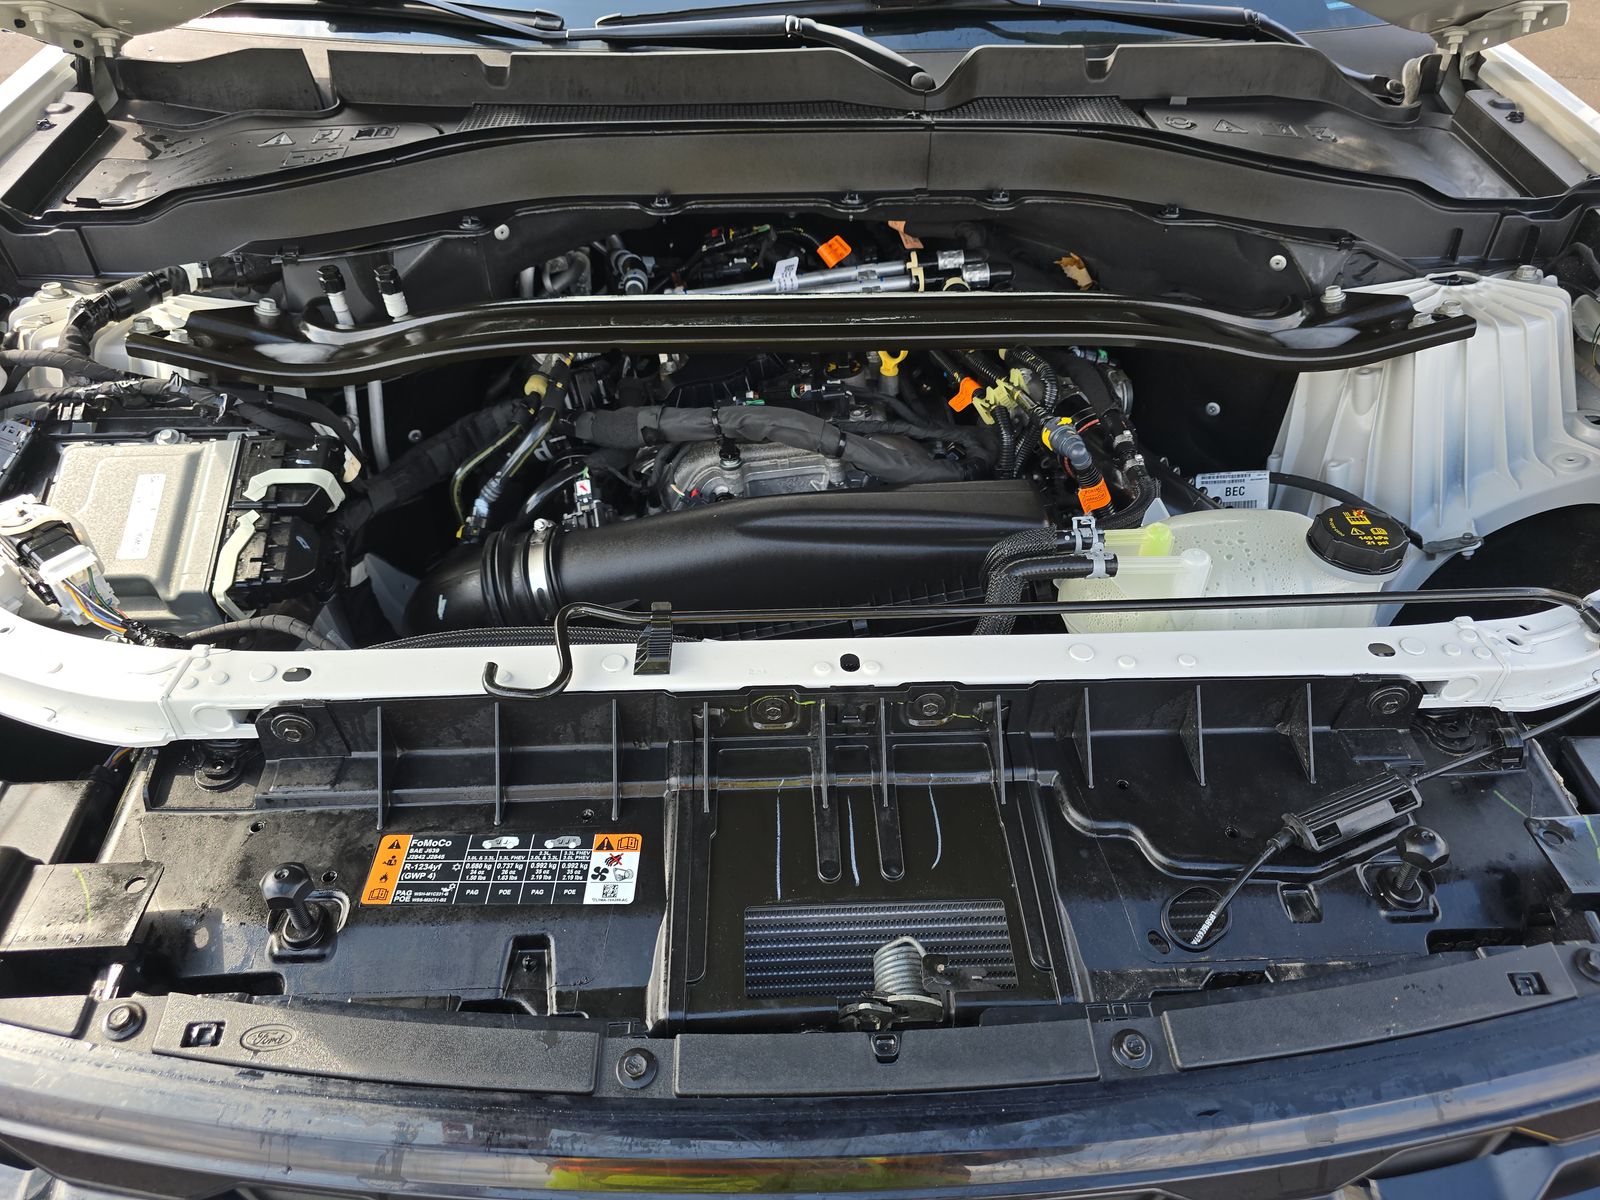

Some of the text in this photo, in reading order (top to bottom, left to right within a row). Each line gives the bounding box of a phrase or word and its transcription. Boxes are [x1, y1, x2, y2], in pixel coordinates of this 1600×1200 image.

[1225, 486, 1246, 496] BEC
[410, 839, 452, 847] FoMoCo
[404, 863, 442, 871] R-1234yf
[401, 872, 436, 880] (GWP 4)
[252, 1031, 285, 1045] Ford
